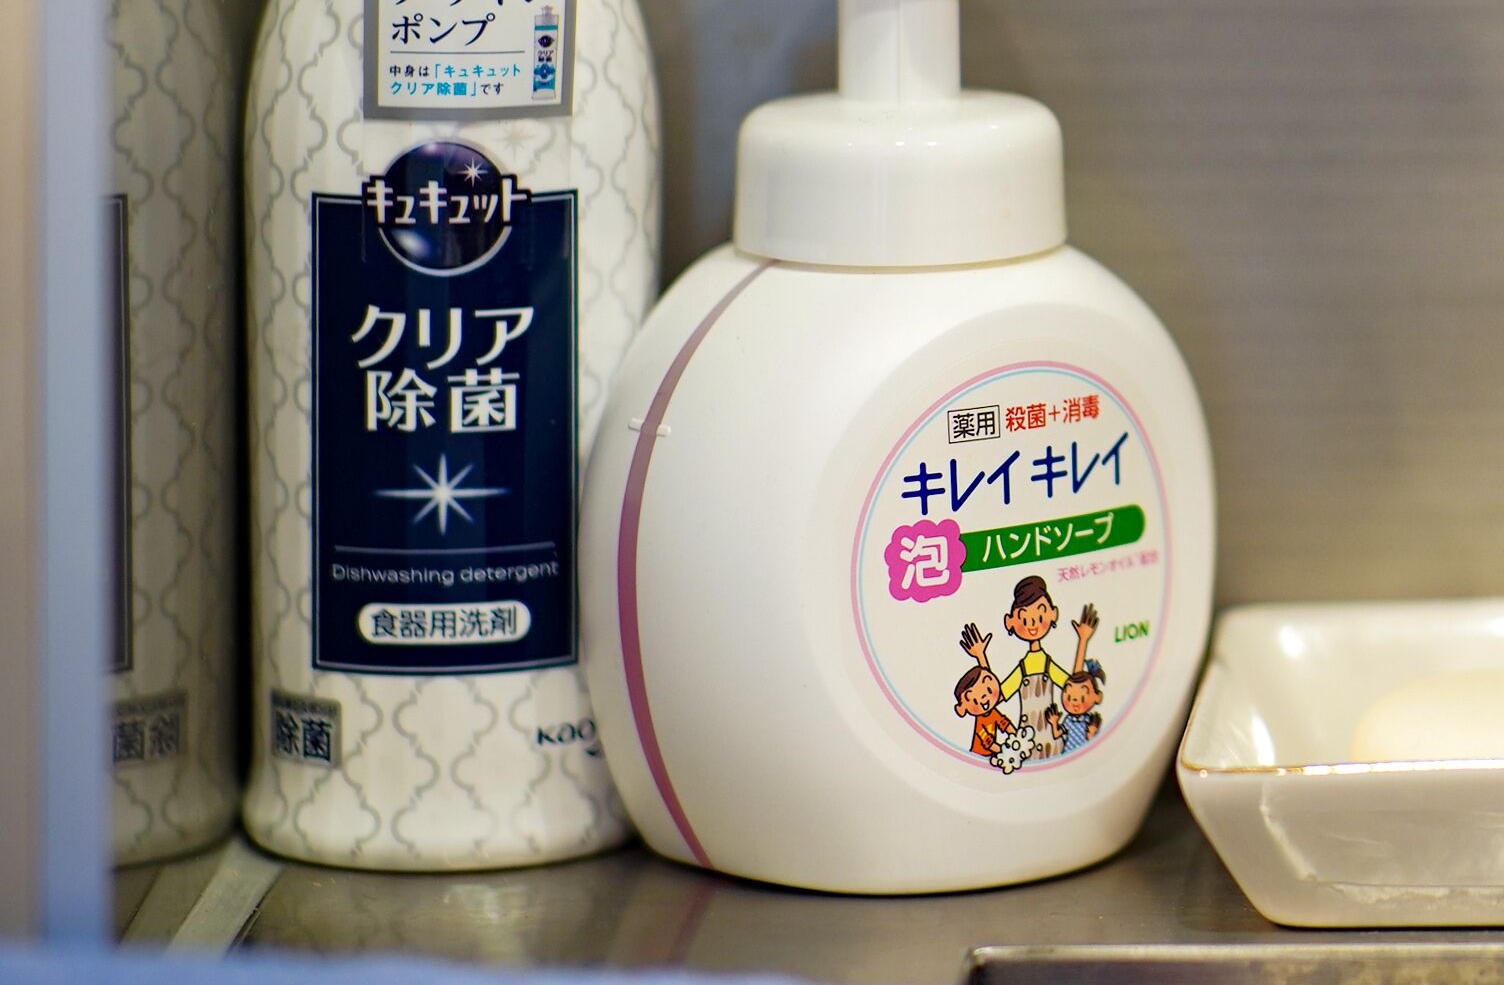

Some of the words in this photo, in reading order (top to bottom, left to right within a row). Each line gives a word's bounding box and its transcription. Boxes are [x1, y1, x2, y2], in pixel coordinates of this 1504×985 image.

[391, 12, 496, 47] ポンプ
[389, 63, 521, 78] 中身は「キュキュット
[390, 81, 504, 97] クリア除菌」です
[366, 177, 528, 224] キュキュット
[352, 304, 534, 370] クリア
[366, 368, 520, 433] 除菌
[952, 411, 997, 439] 薬用
[899, 534, 951, 590] 泡
[982, 512, 1116, 563] ハンドソープ
[332, 563, 455, 587] Dishwashing
[460, 560, 560, 585] detergent
[371, 607, 517, 639] 食器用洗剤
[1114, 619, 1150, 643] LION
